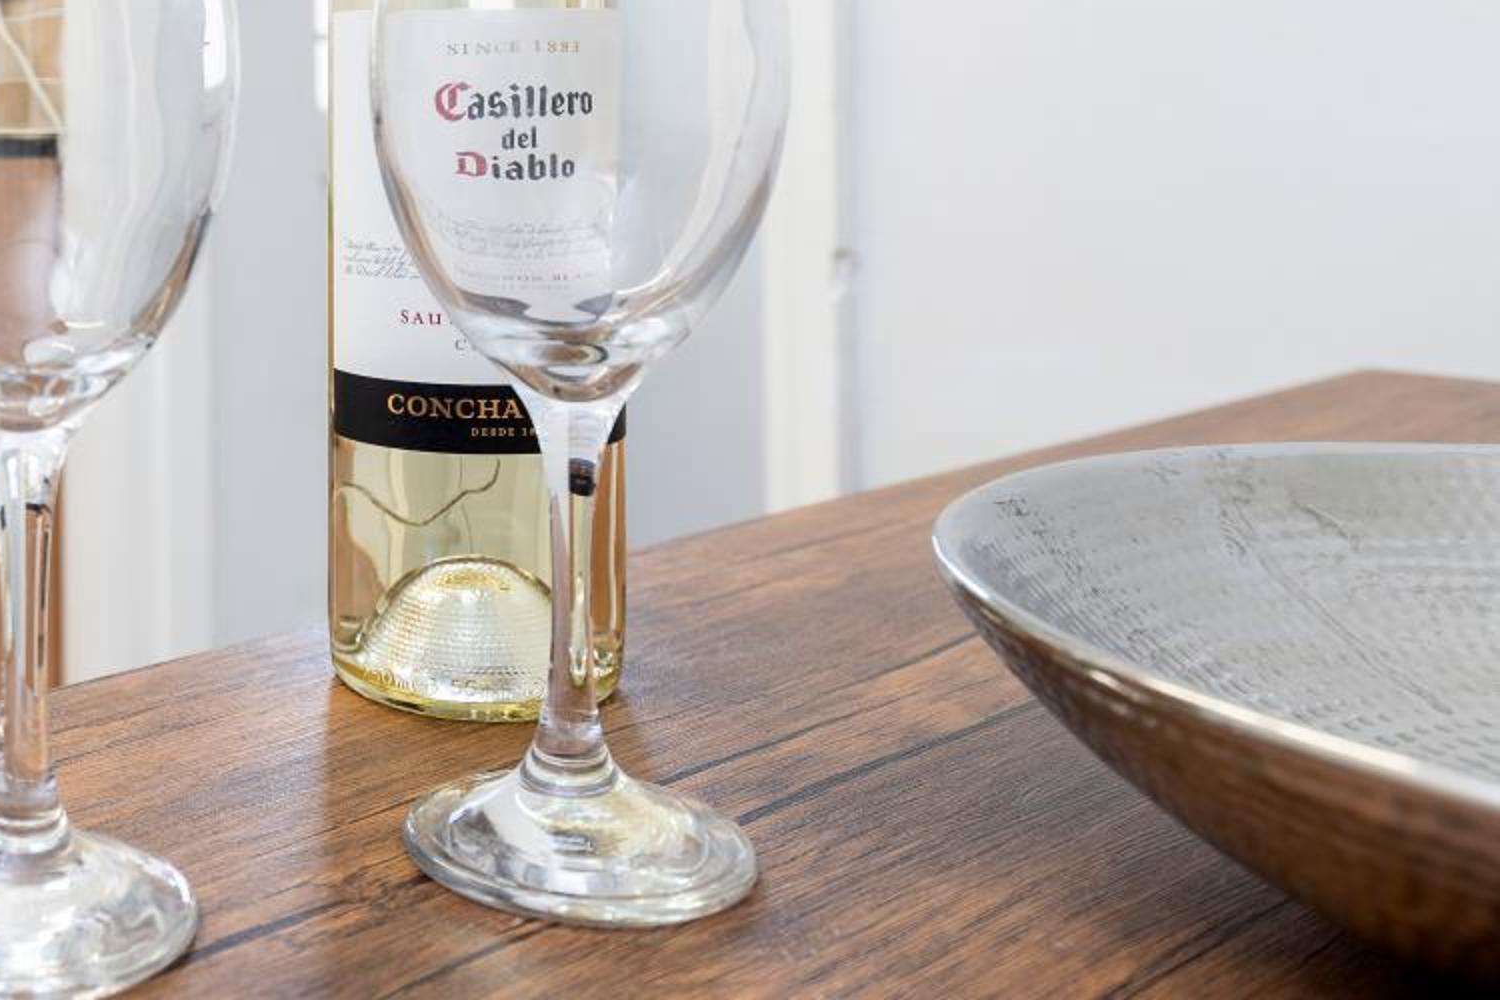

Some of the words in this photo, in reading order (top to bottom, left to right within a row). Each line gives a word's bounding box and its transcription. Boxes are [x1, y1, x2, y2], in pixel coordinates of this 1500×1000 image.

[446, 39, 519, 55] SINCE
[434, 81, 593, 122] Casillero
[501, 125, 538, 150] del
[454, 150, 576, 181] Diablo
[386, 392, 524, 420] CONCHA
[470, 426, 515, 438] DESDE
